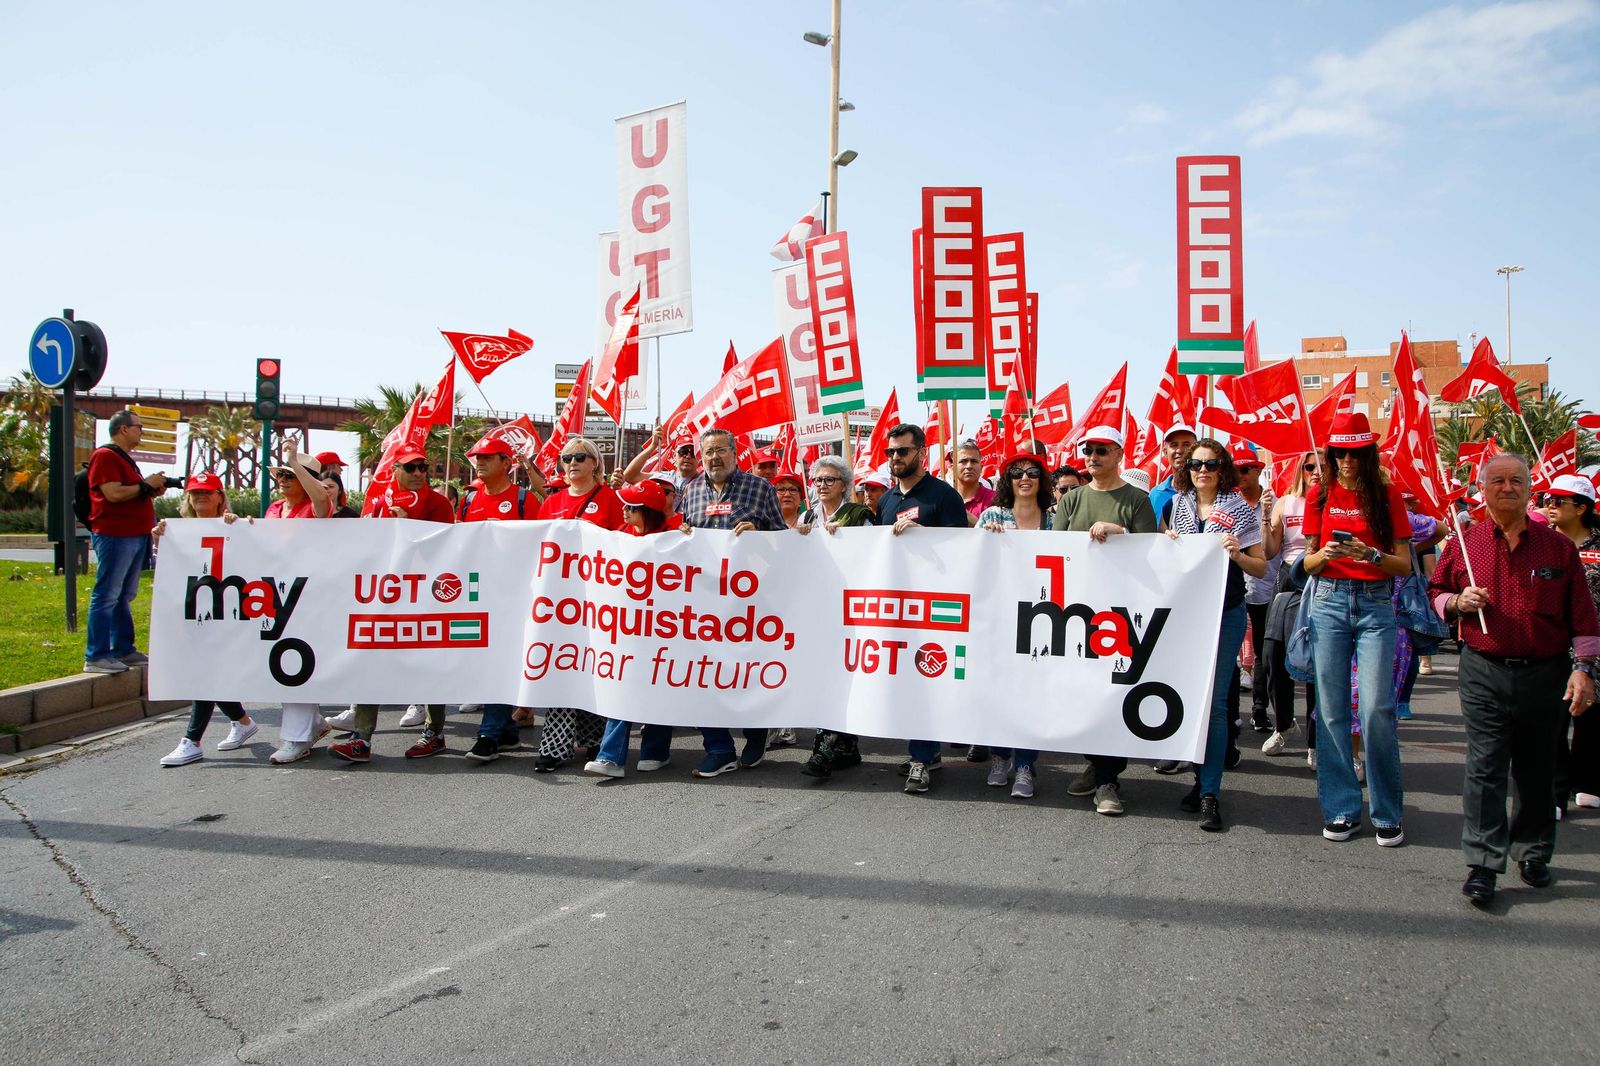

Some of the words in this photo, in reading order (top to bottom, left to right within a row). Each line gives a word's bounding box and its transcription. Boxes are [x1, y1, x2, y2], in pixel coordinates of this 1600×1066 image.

[631, 117, 671, 300] UGT
[1188, 164, 1231, 334] CCOO
[933, 195, 974, 361] CCOO
[640, 305, 683, 325] MERÍA
[813, 239, 854, 382] CCOO
[620, 388, 640, 400] ERÍA
[799, 419, 841, 436] LMERÍA
[354, 573, 427, 604] UGT
[537, 541, 702, 601] Proteger
[719, 558, 759, 598] lo
[531, 596, 795, 651] conquistado,
[848, 596, 924, 622] CCOO
[353, 620, 443, 642] CCOO
[524, 641, 634, 681] ganar
[651, 646, 787, 690] futuro
[844, 638, 907, 675] UGT
